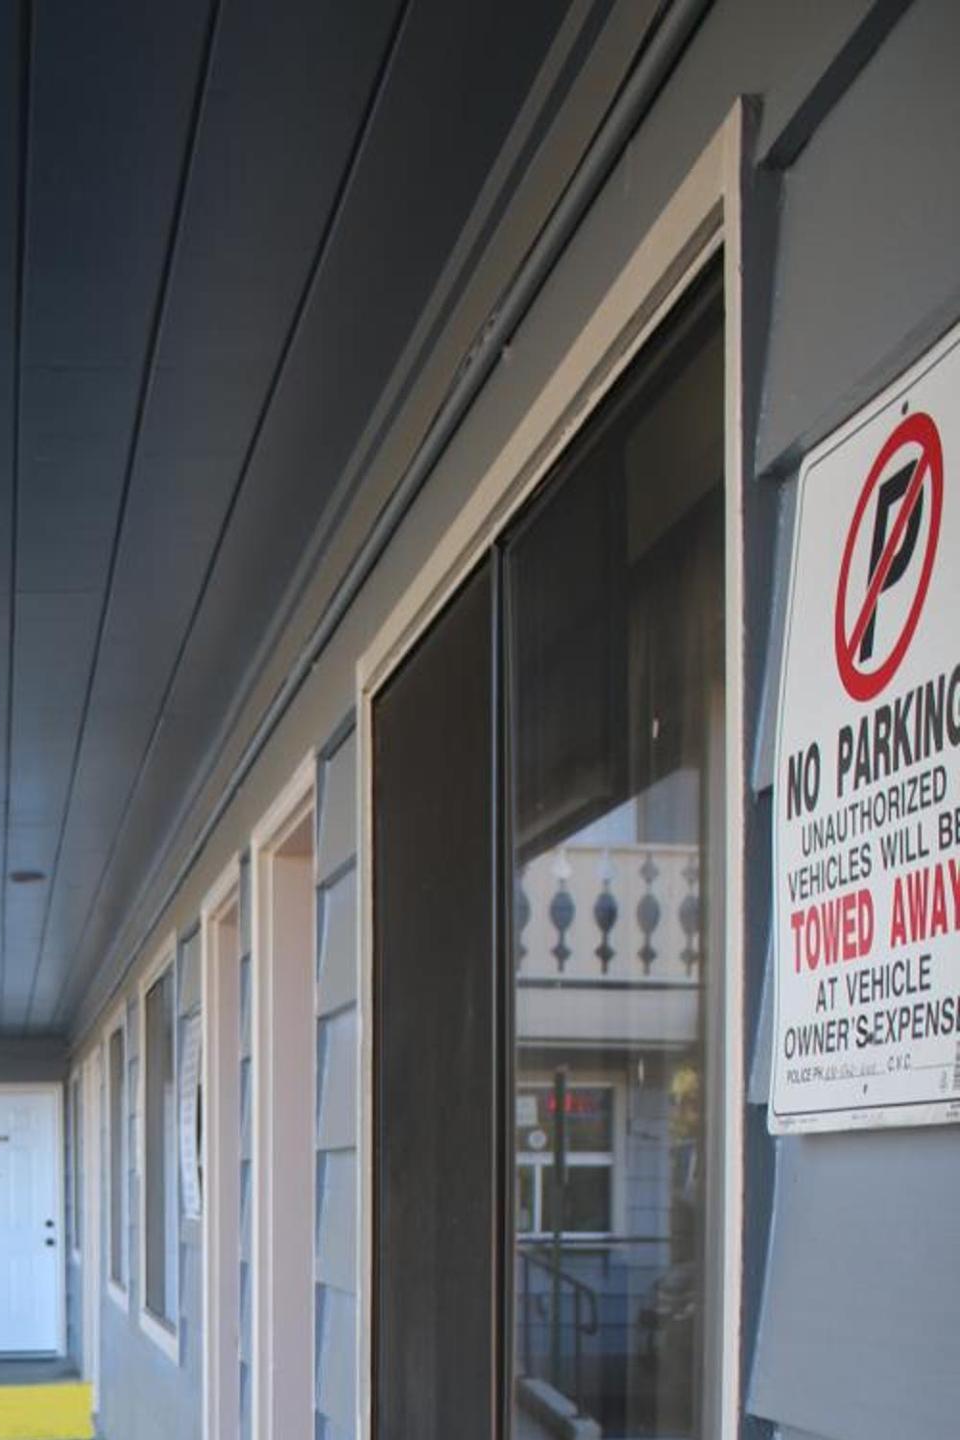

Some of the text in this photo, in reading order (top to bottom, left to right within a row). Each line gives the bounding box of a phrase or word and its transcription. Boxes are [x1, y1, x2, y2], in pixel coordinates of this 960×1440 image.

[787, 664, 960, 821] NO PARKING
[802, 765, 947, 857] UNAUTHORIZED
[788, 843, 872, 902] VEHICLES
[880, 822, 930, 870] WILL
[791, 859, 960, 974] TOWED AWAY
[816, 953, 932, 1013] AT VEHICLE
[784, 1015, 870, 1060] OWNER'S
